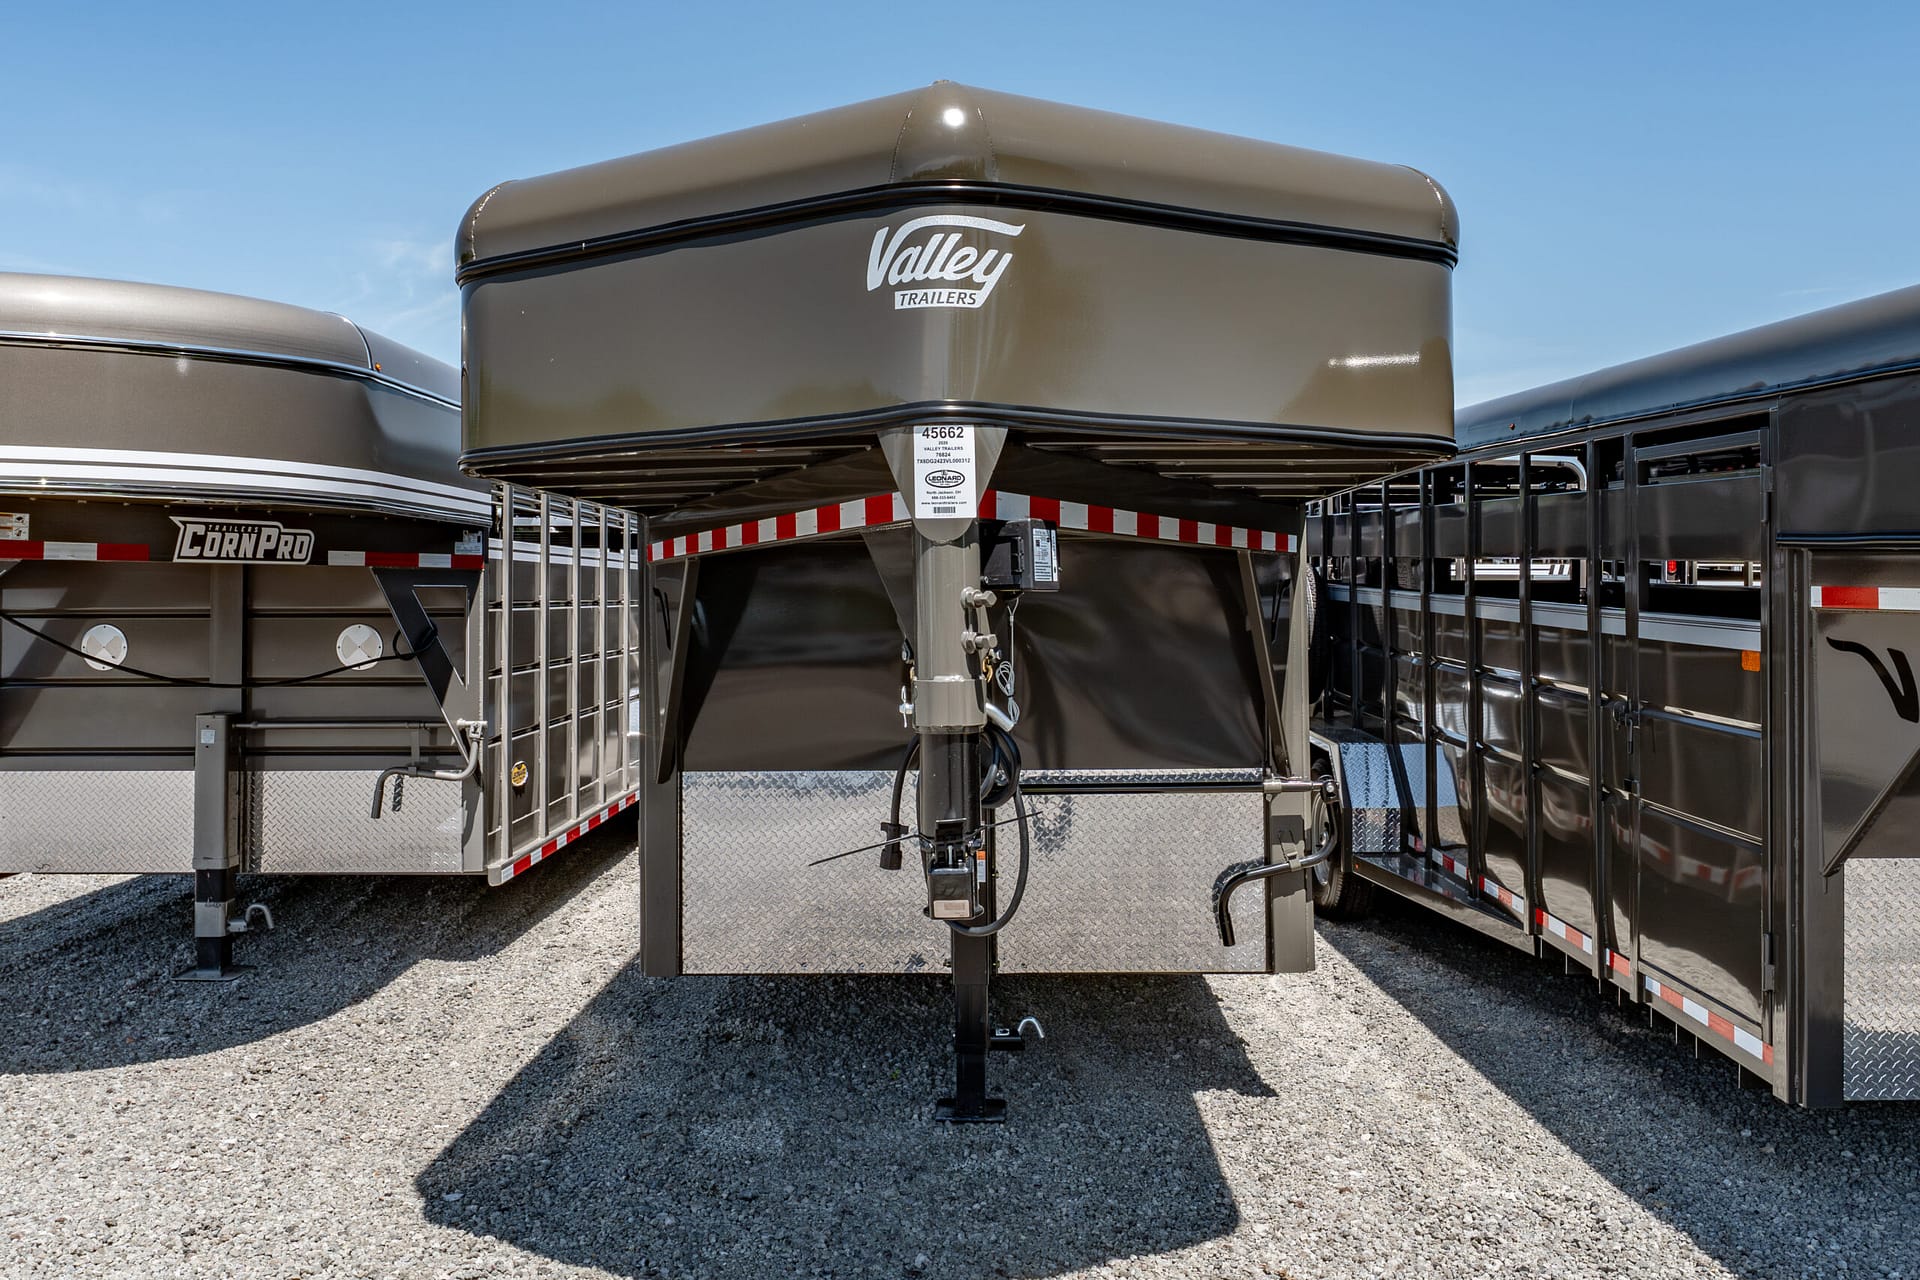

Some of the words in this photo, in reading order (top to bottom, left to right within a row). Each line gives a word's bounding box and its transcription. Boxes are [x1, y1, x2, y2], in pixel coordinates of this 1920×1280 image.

[866, 214, 1026, 309] Valley
[900, 291, 977, 306] TRAILERS
[922, 426, 964, 439] 45662
[208, 524, 259, 533] TRAILERS
